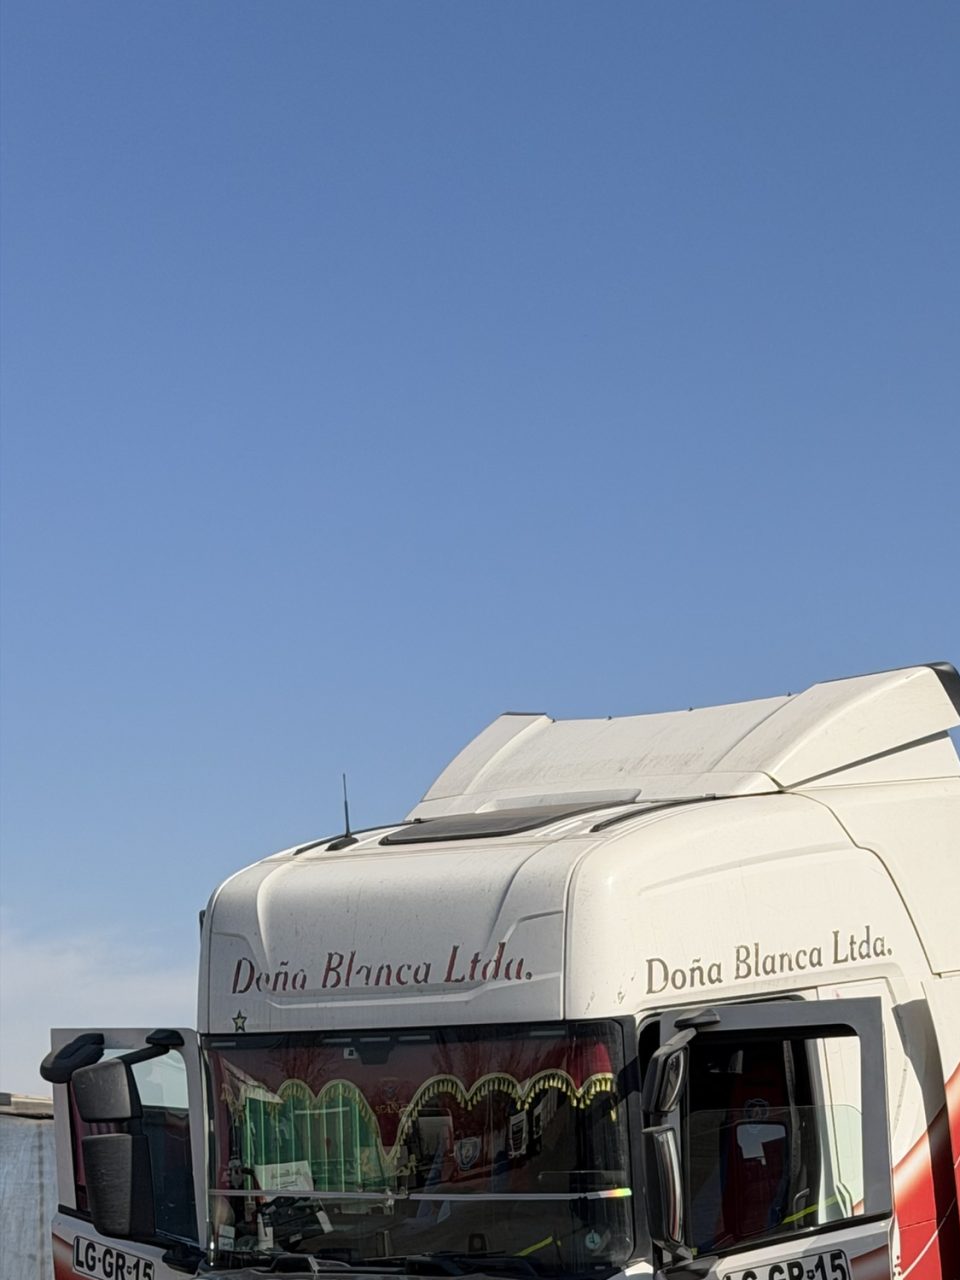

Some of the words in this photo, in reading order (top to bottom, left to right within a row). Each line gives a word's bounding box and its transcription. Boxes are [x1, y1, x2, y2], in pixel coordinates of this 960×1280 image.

[232, 957, 307, 994] Doña
[321, 950, 431, 989] Blanca
[444, 941, 534, 984] Ltda.
[646, 957, 724, 995] Doña
[734, 942, 823, 980] Blanca
[832, 925, 893, 964] Ltda.
